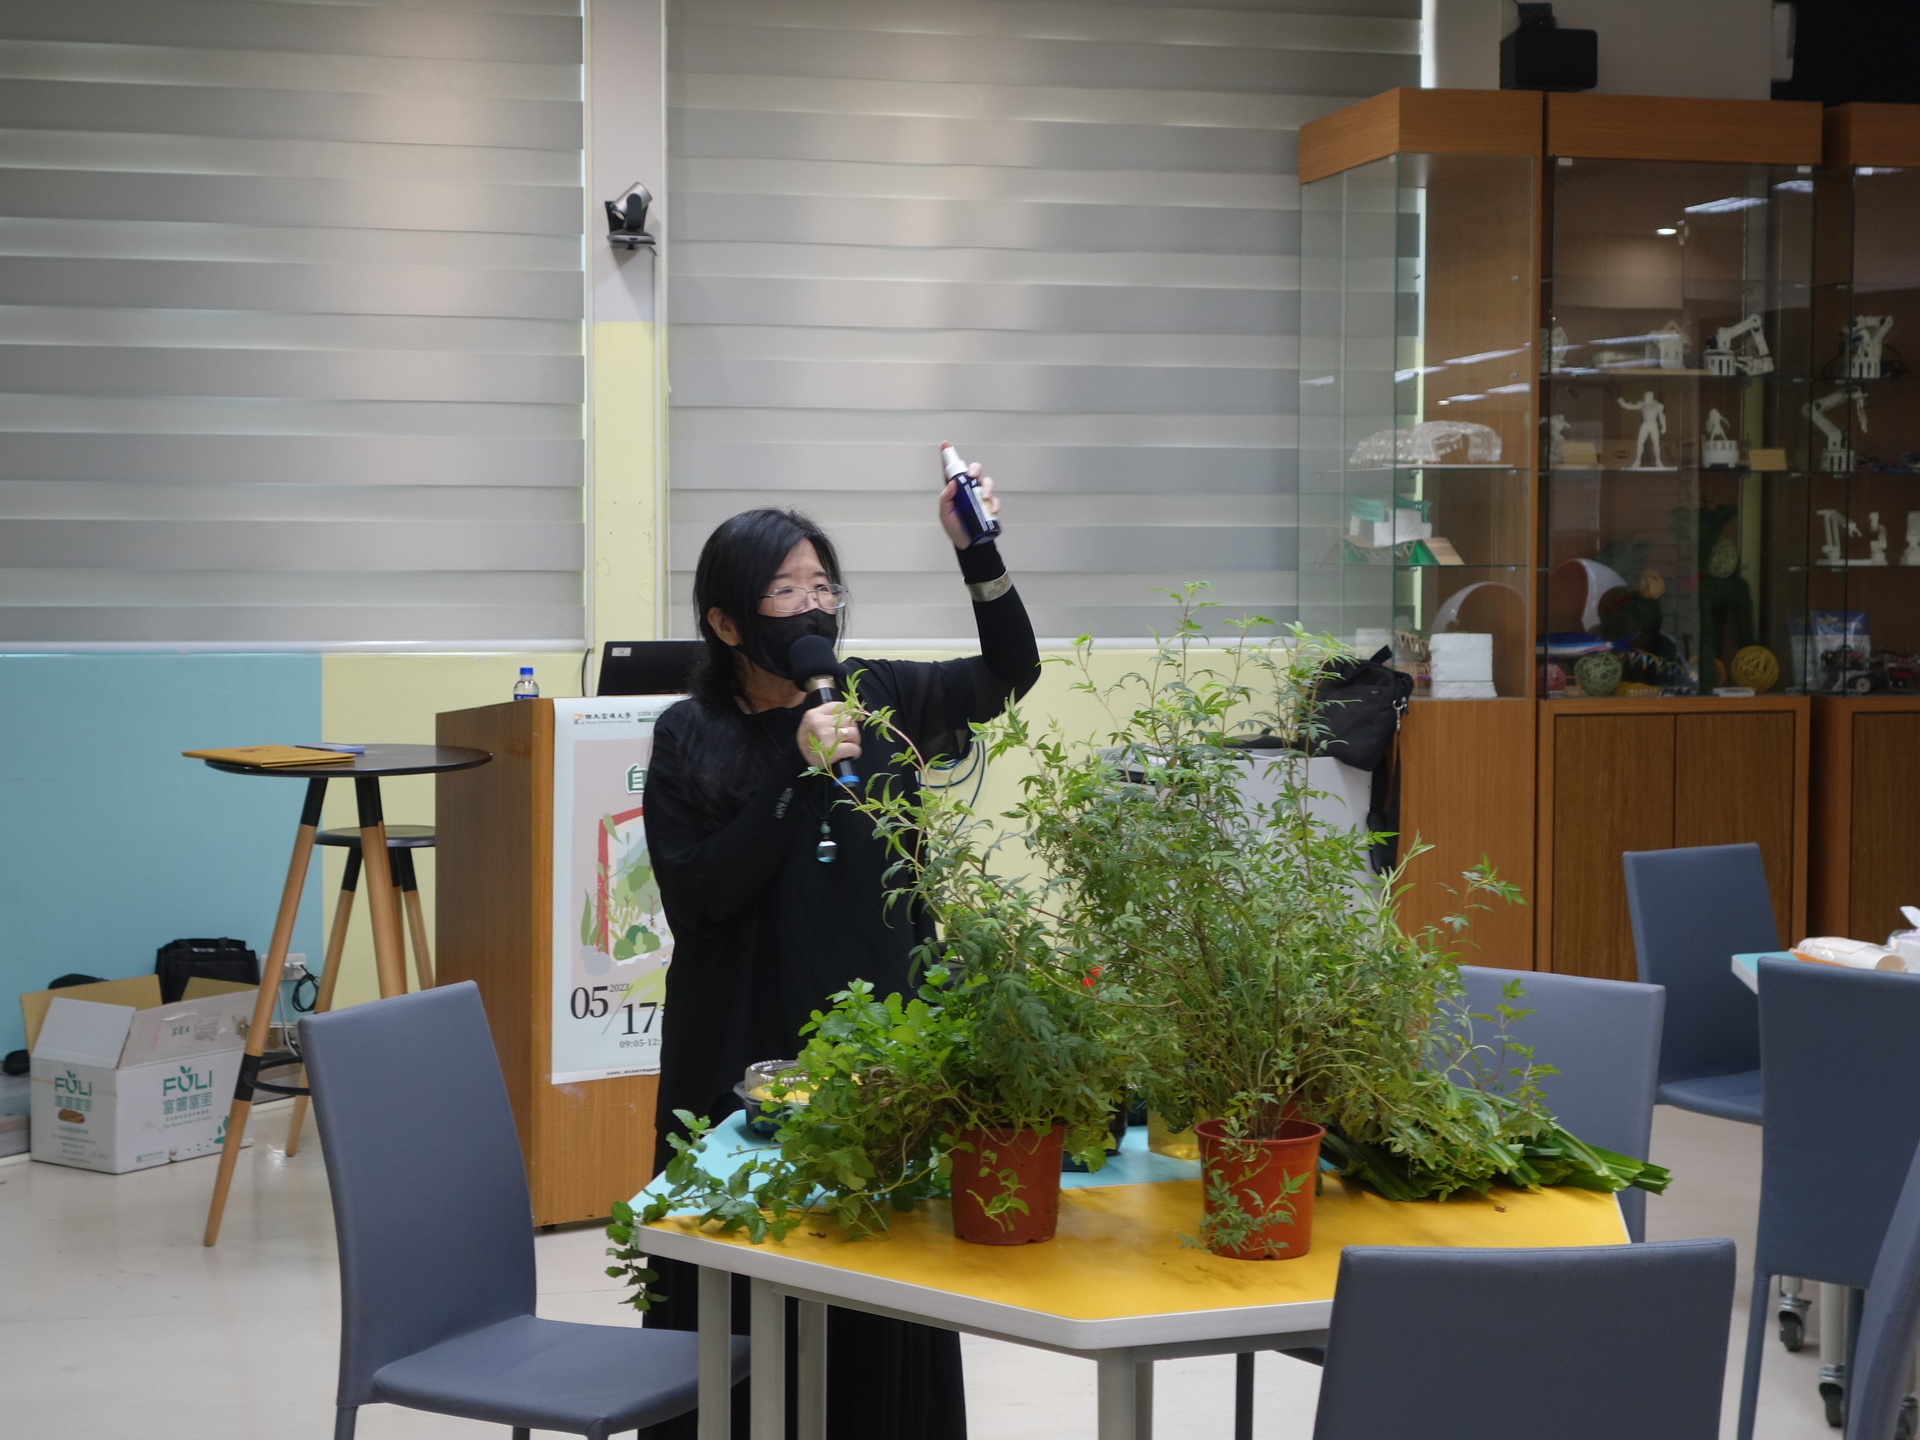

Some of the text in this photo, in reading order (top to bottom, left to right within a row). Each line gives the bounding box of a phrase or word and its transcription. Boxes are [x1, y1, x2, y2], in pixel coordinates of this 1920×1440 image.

[570, 983, 630, 1020] 05 2023
[621, 1002, 657, 1035] 17
[619, 1038, 661, 1048] 09:05-12:
[54, 1077, 92, 1096] FULI
[162, 1070, 213, 1097] FULI
